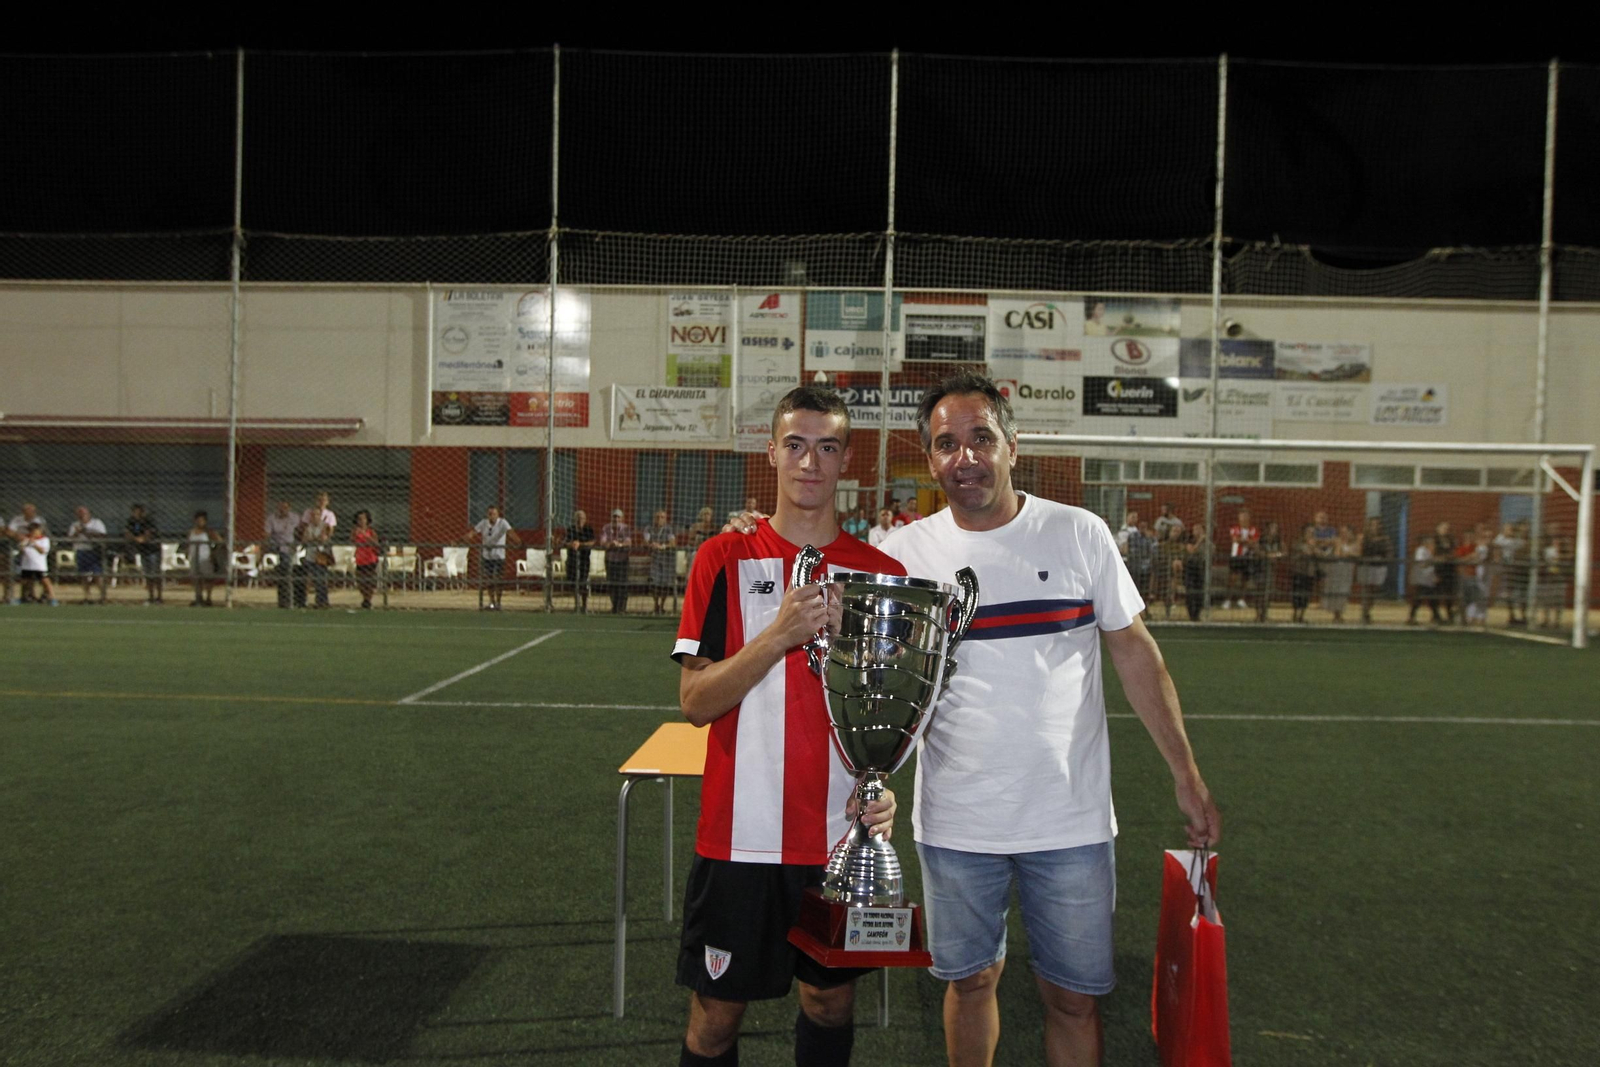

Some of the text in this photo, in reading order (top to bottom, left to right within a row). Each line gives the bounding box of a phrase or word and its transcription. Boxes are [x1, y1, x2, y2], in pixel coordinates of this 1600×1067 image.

[1004, 310, 1054, 329] CASI
[671, 325, 727, 343] NOVI
[834, 342, 897, 359] cajamr
[635, 389, 707, 400] EL CHAPARRITA
[862, 389, 925, 405] HYUND
